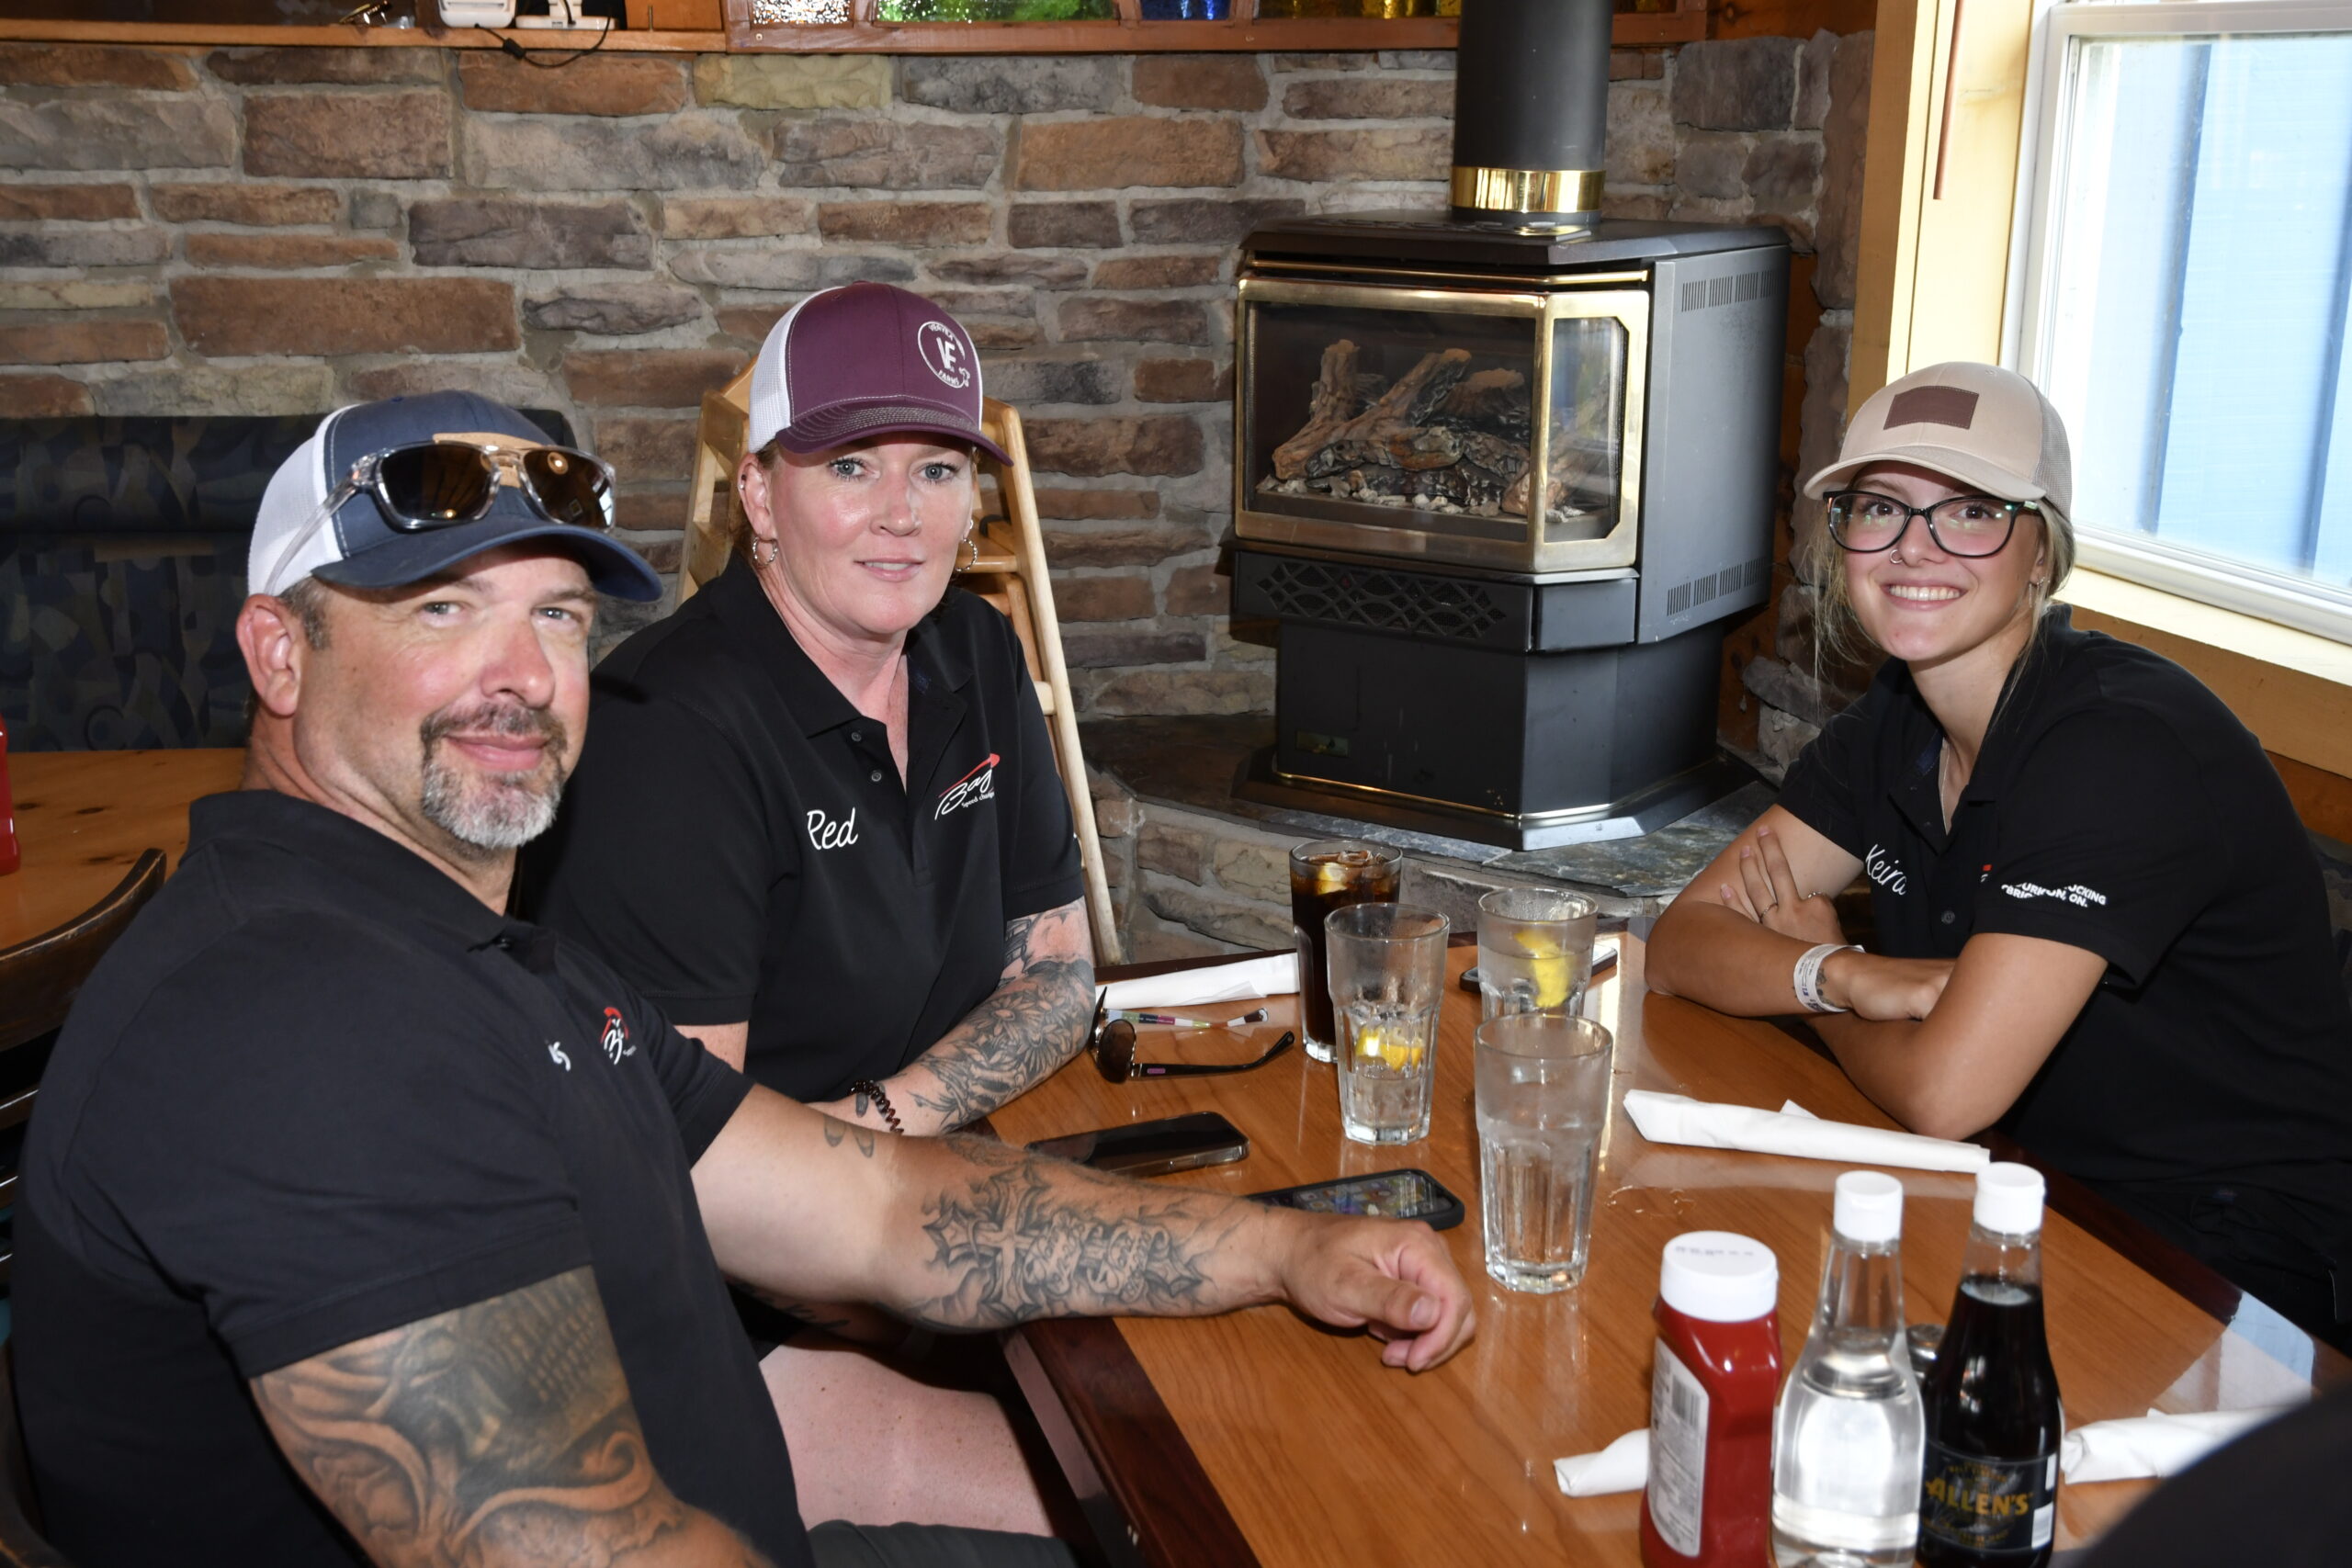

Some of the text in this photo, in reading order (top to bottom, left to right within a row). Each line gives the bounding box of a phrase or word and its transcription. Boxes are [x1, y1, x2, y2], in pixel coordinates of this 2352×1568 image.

[807, 807, 858, 850] Red
[1865, 843, 1907, 896] Keira
[2069, 893, 2088, 908] ON.
[1926, 1477, 2030, 1516] ALLEN'S
